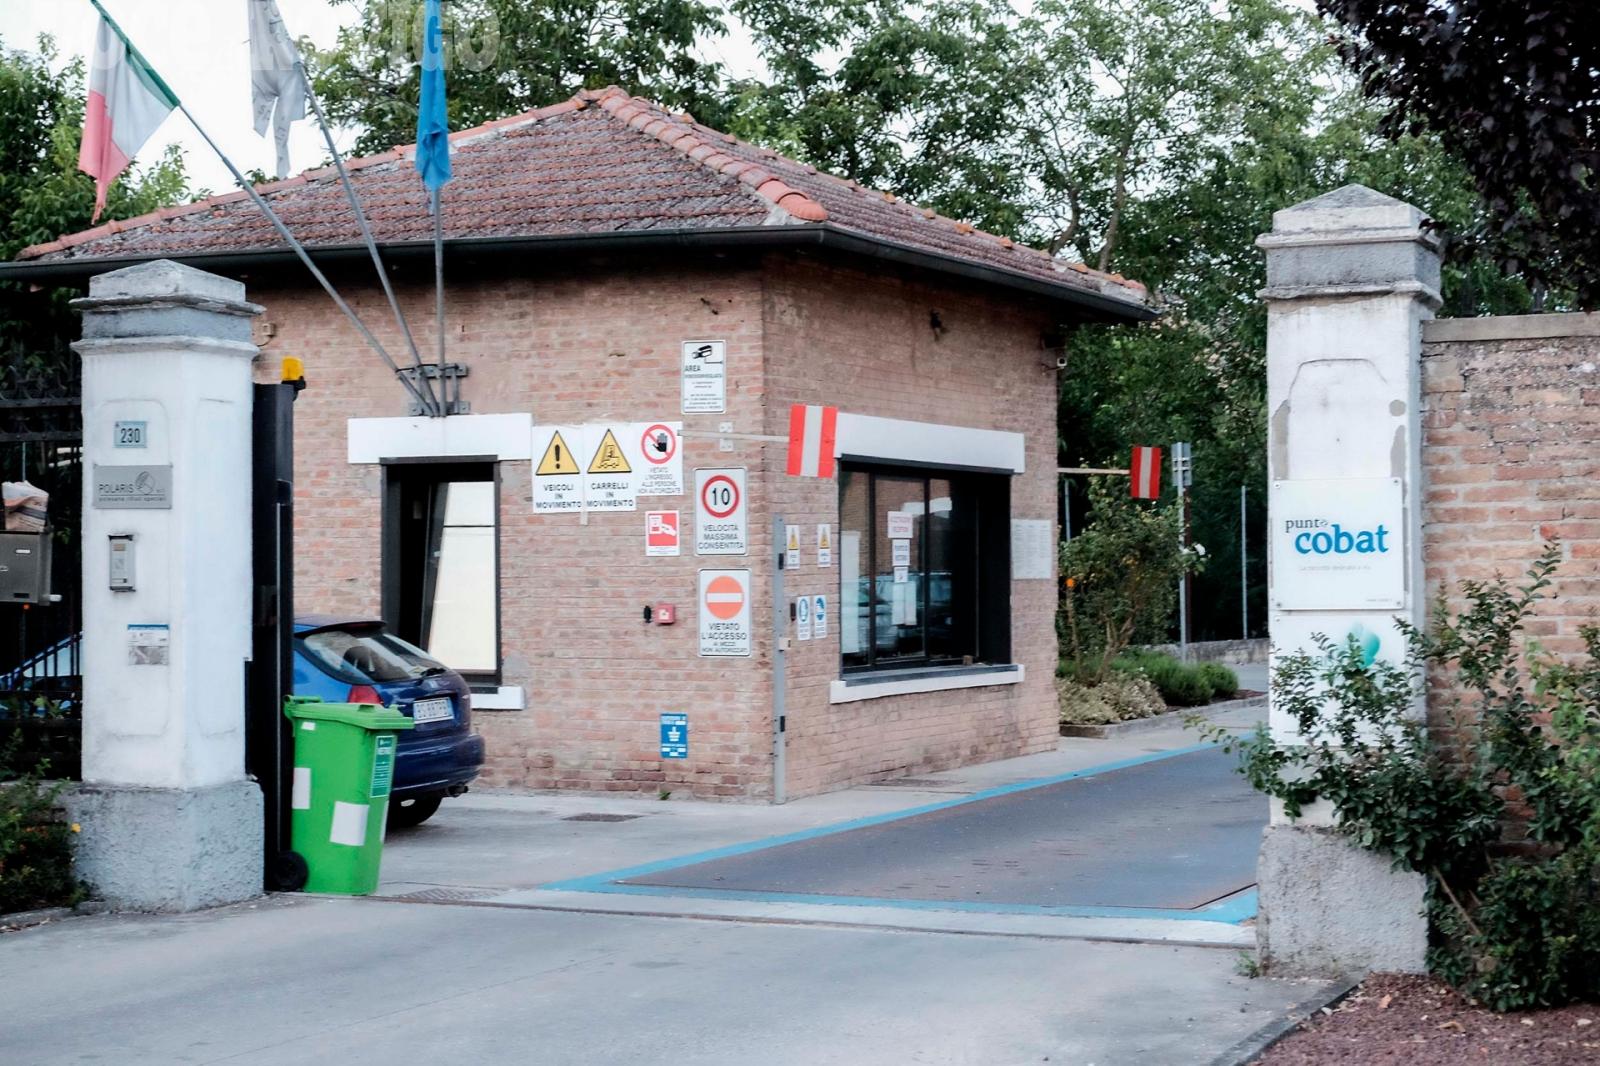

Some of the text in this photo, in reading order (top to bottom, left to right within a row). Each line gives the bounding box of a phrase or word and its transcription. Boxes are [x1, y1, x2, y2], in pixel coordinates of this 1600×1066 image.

[120, 428, 141, 443] 230
[98, 483, 134, 493] POLARIS
[543, 483, 574, 491] VEICOLI
[591, 482, 629, 490] CARRELLI
[712, 488, 731, 506] 10
[536, 501, 582, 509] MOVIMENTO
[586, 500, 634, 508] MOVIMENTO
[703, 533, 738, 541] MASSIMA
[1295, 524, 1389, 554] cobat
[698, 542, 744, 550] CONSENTITA
[708, 622, 740, 631] VIETATO
[701, 632, 747, 640] L'ACCESSO
